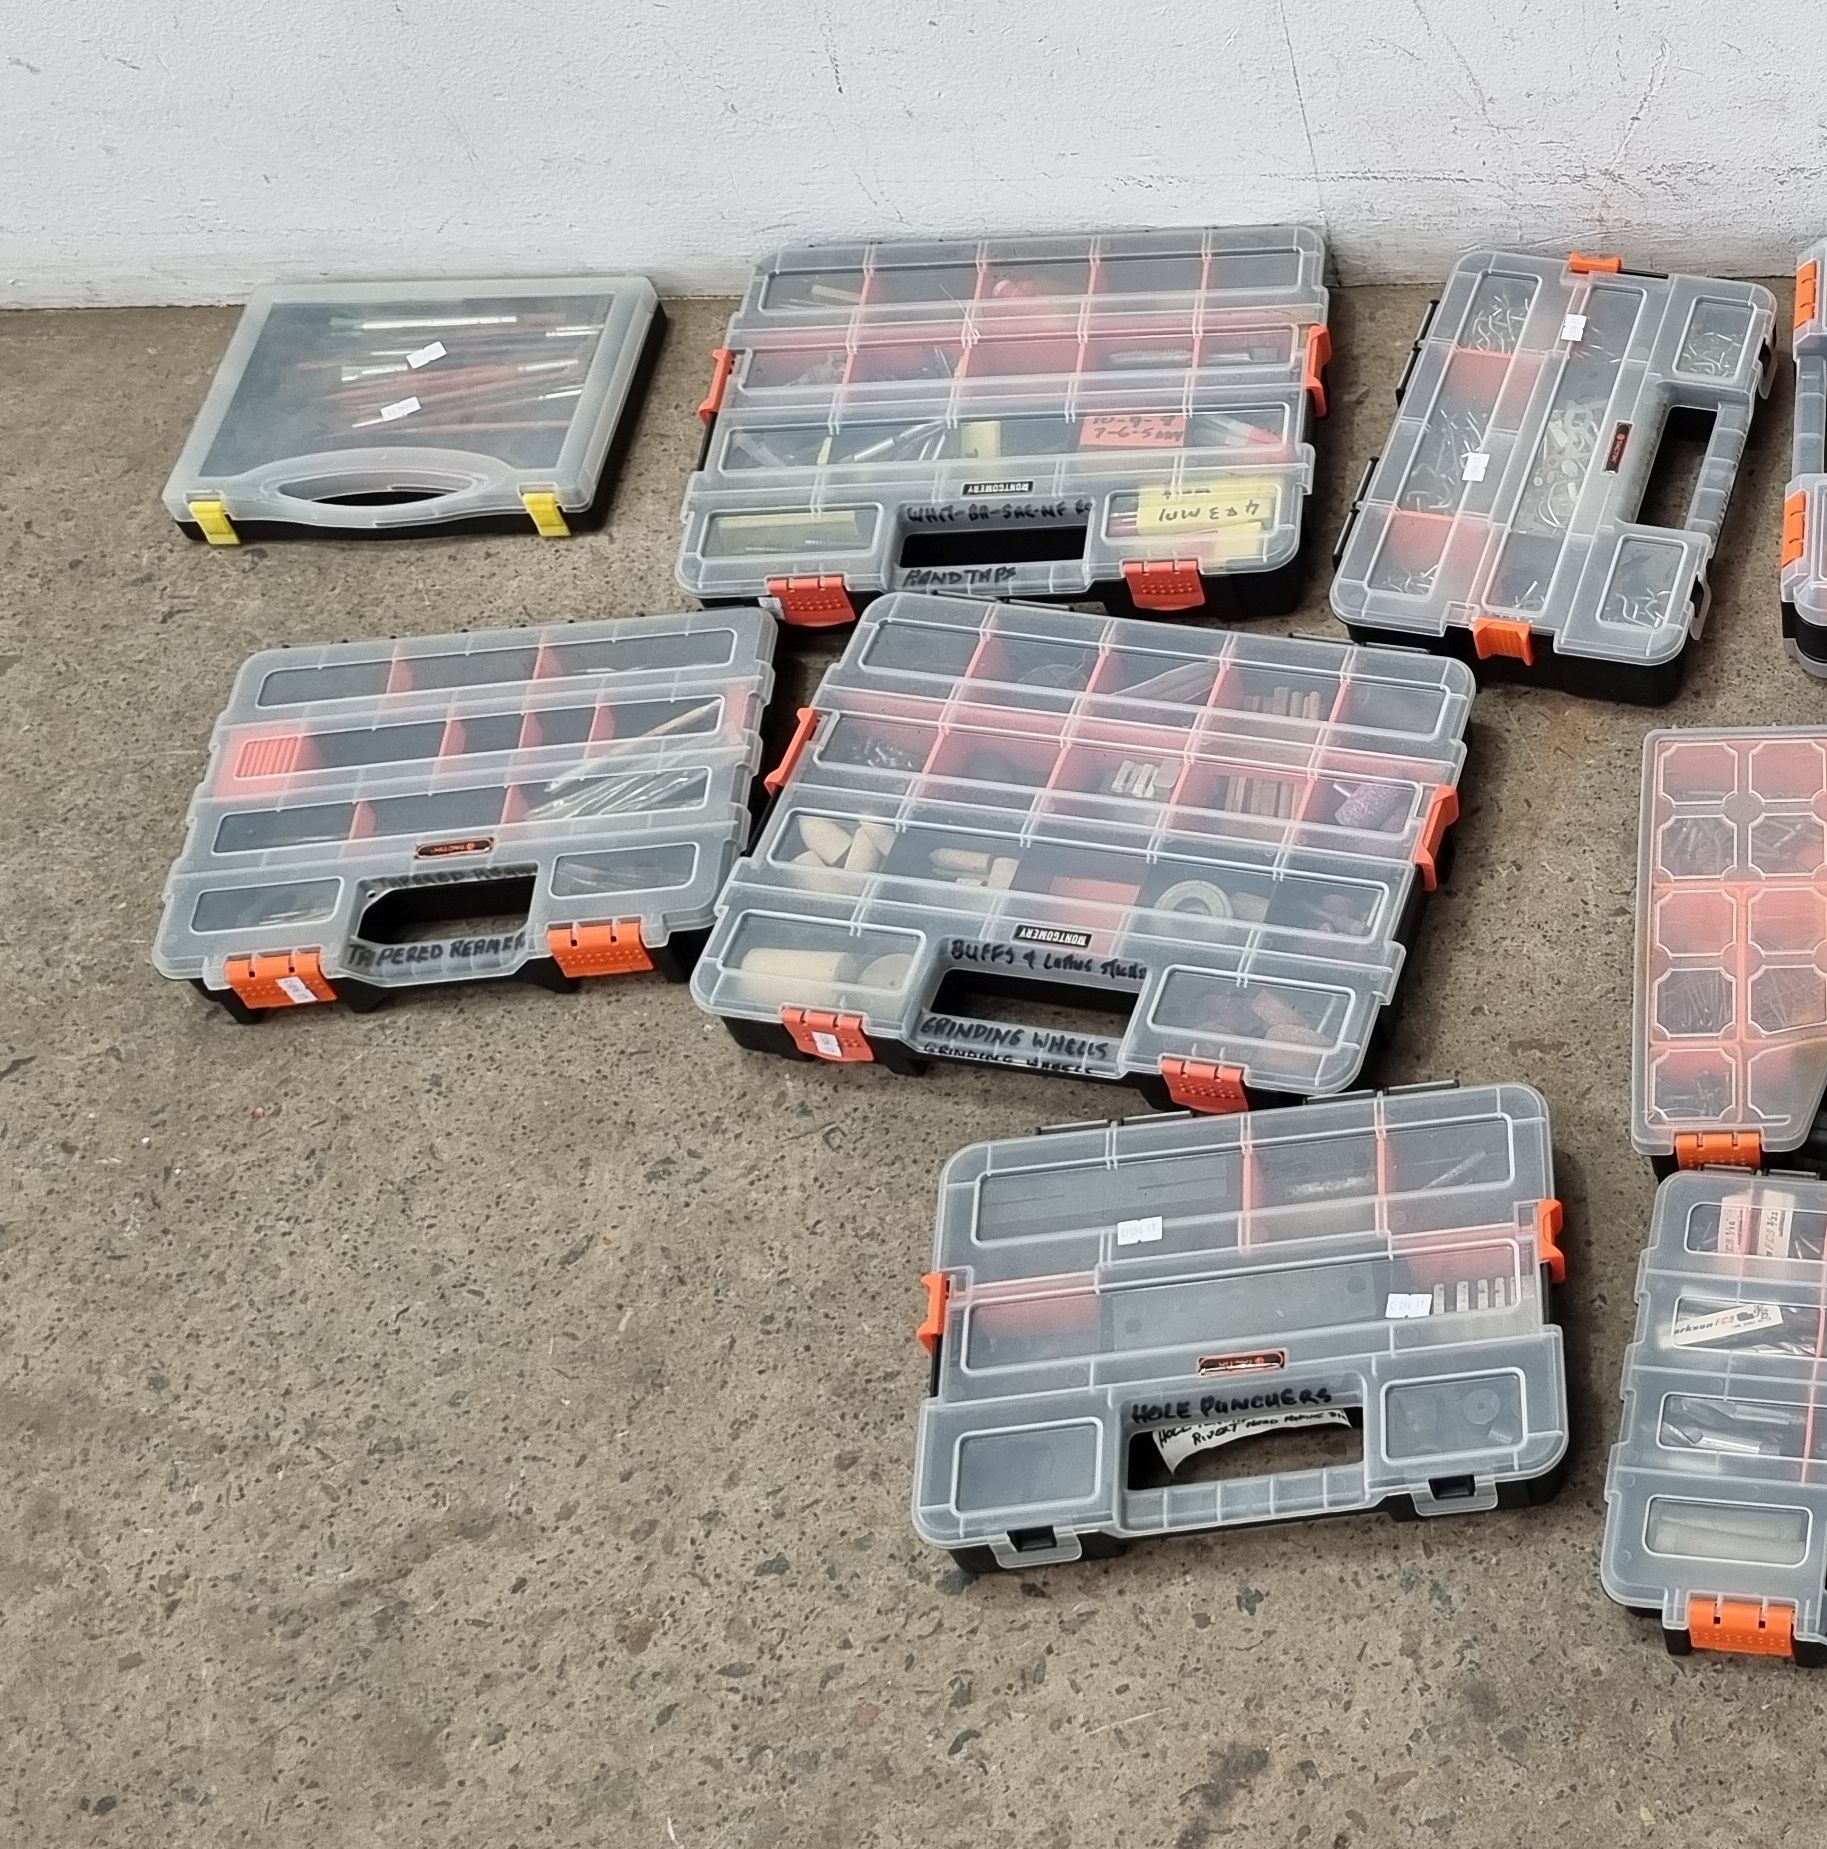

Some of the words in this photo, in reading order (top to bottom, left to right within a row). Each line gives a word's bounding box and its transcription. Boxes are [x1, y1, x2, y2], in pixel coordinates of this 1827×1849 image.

[967, 482, 1030, 494] MONTGOMERY
[1019, 927, 1088, 947] MONTGOMERY
[347, 939, 444, 968] TAPERED
[951, 938, 1014, 965] BUFFS
[919, 1016, 1025, 1046] GRINDING
[1131, 1401, 1192, 1424] HOLE
[1200, 1387, 1333, 1417] PUNCHERS
